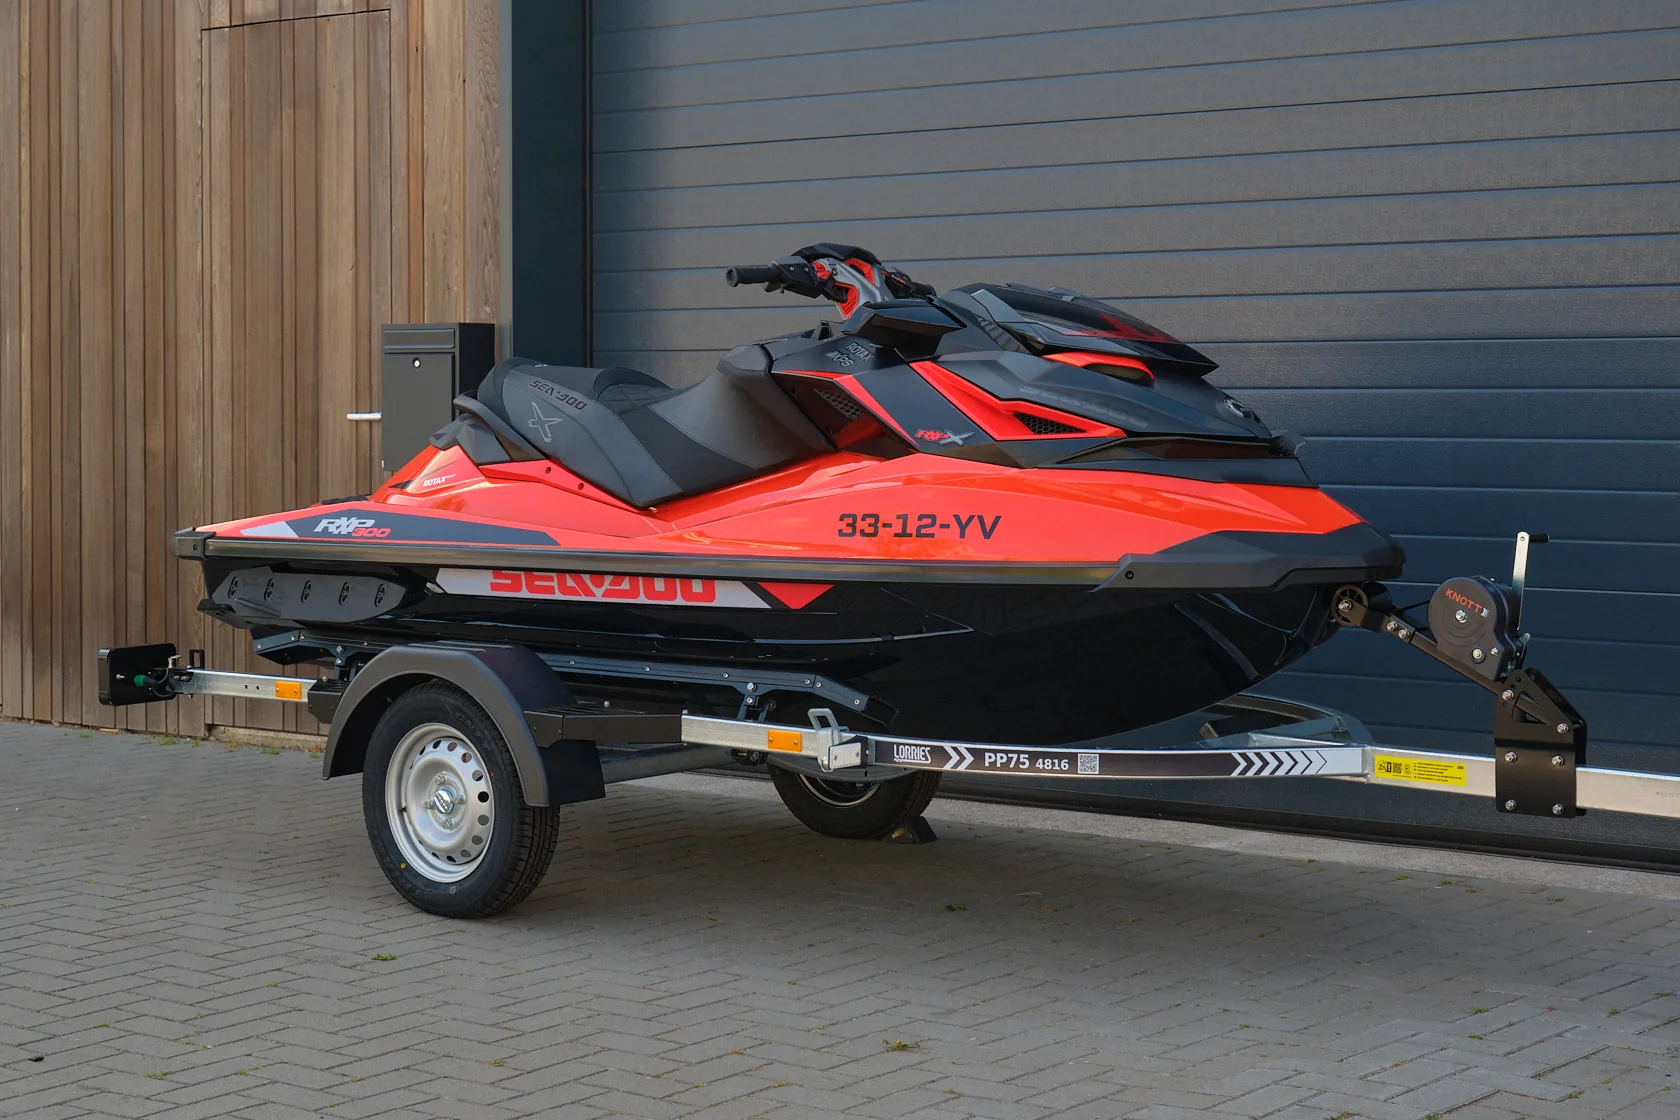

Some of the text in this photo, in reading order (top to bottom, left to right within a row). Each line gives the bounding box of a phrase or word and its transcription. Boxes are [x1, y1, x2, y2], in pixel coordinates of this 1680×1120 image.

[422, 476, 447, 487] ROTAX
[313, 516, 392, 538] RXP 300
[837, 513, 1002, 540] 33-12-YV
[1445, 588, 1483, 613] KNOTT
[893, 743, 932, 764] LORRIES
[984, 752, 1069, 771] PP75 4816
